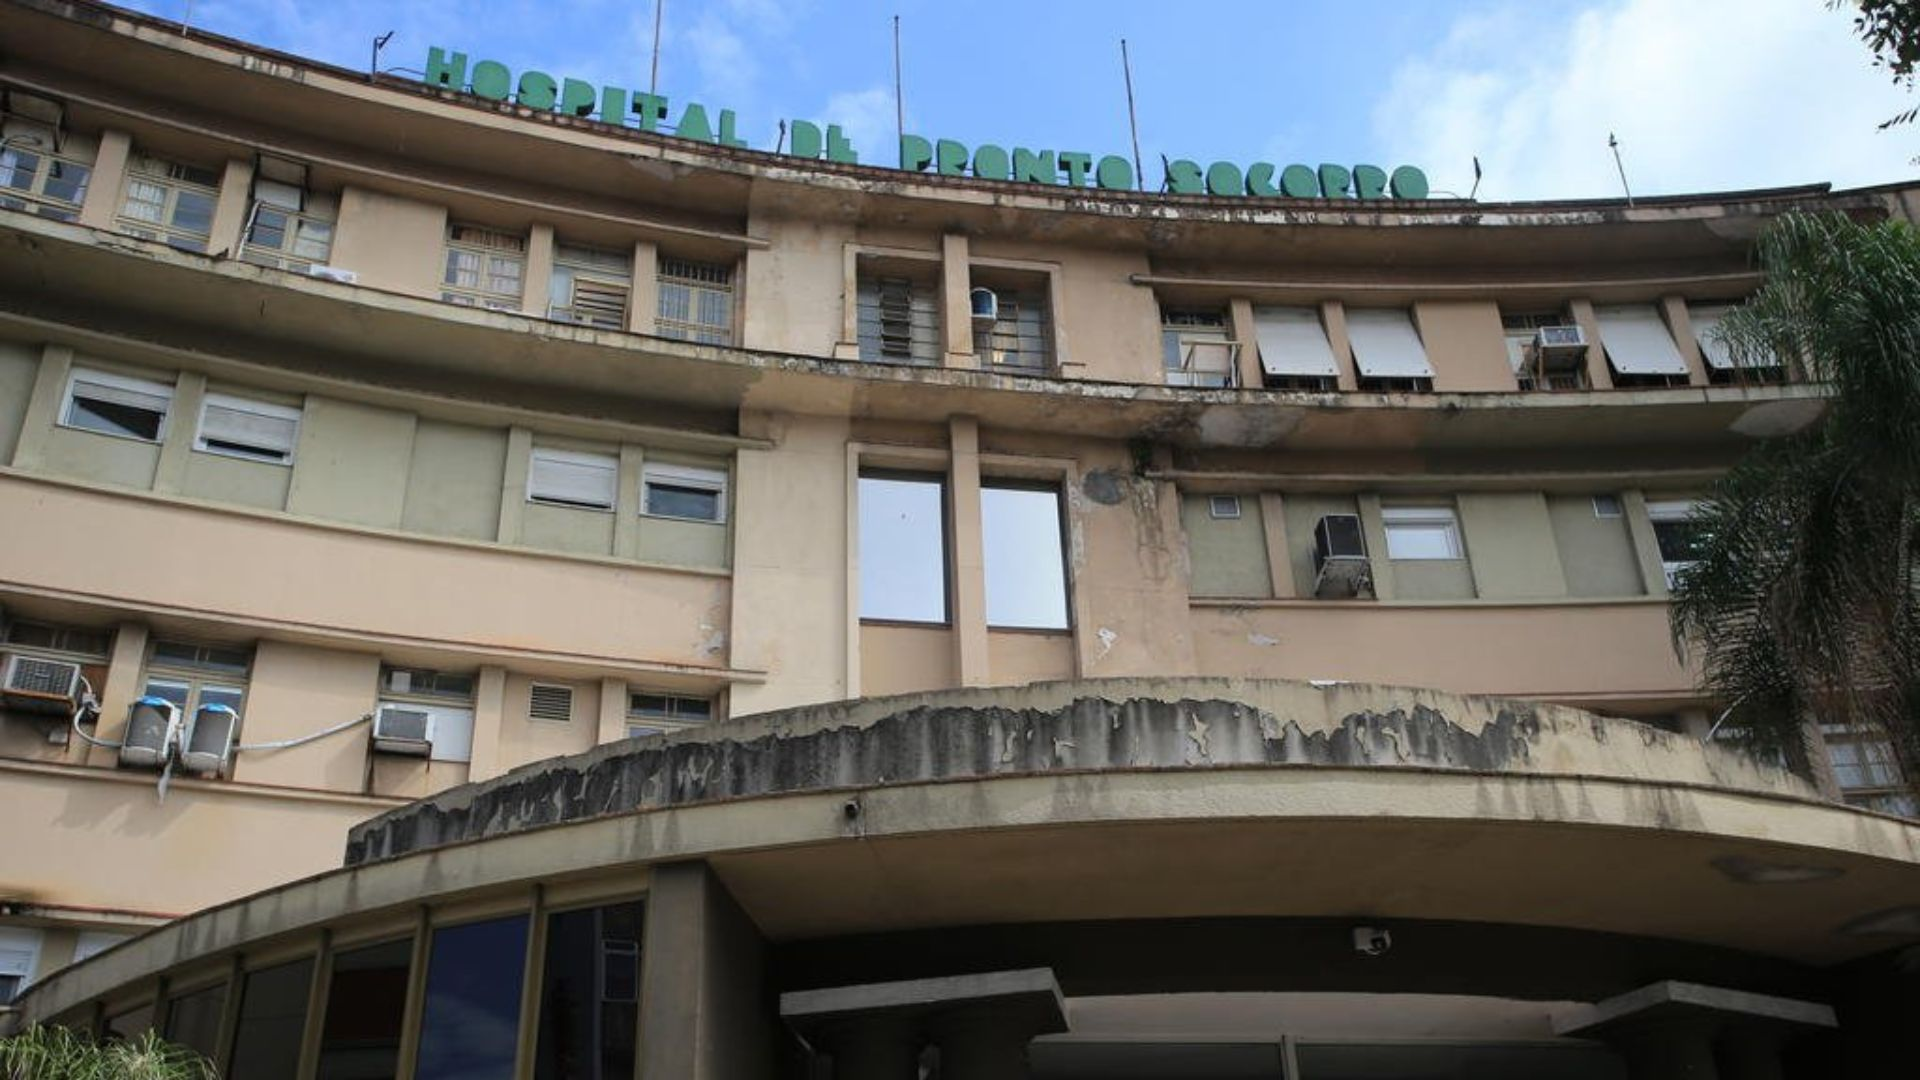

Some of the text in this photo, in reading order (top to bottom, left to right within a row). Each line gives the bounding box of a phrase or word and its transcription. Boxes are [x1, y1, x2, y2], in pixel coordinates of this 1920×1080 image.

[425, 46, 1429, 200] HOSPITAL DE PRONTO SOCORRO
